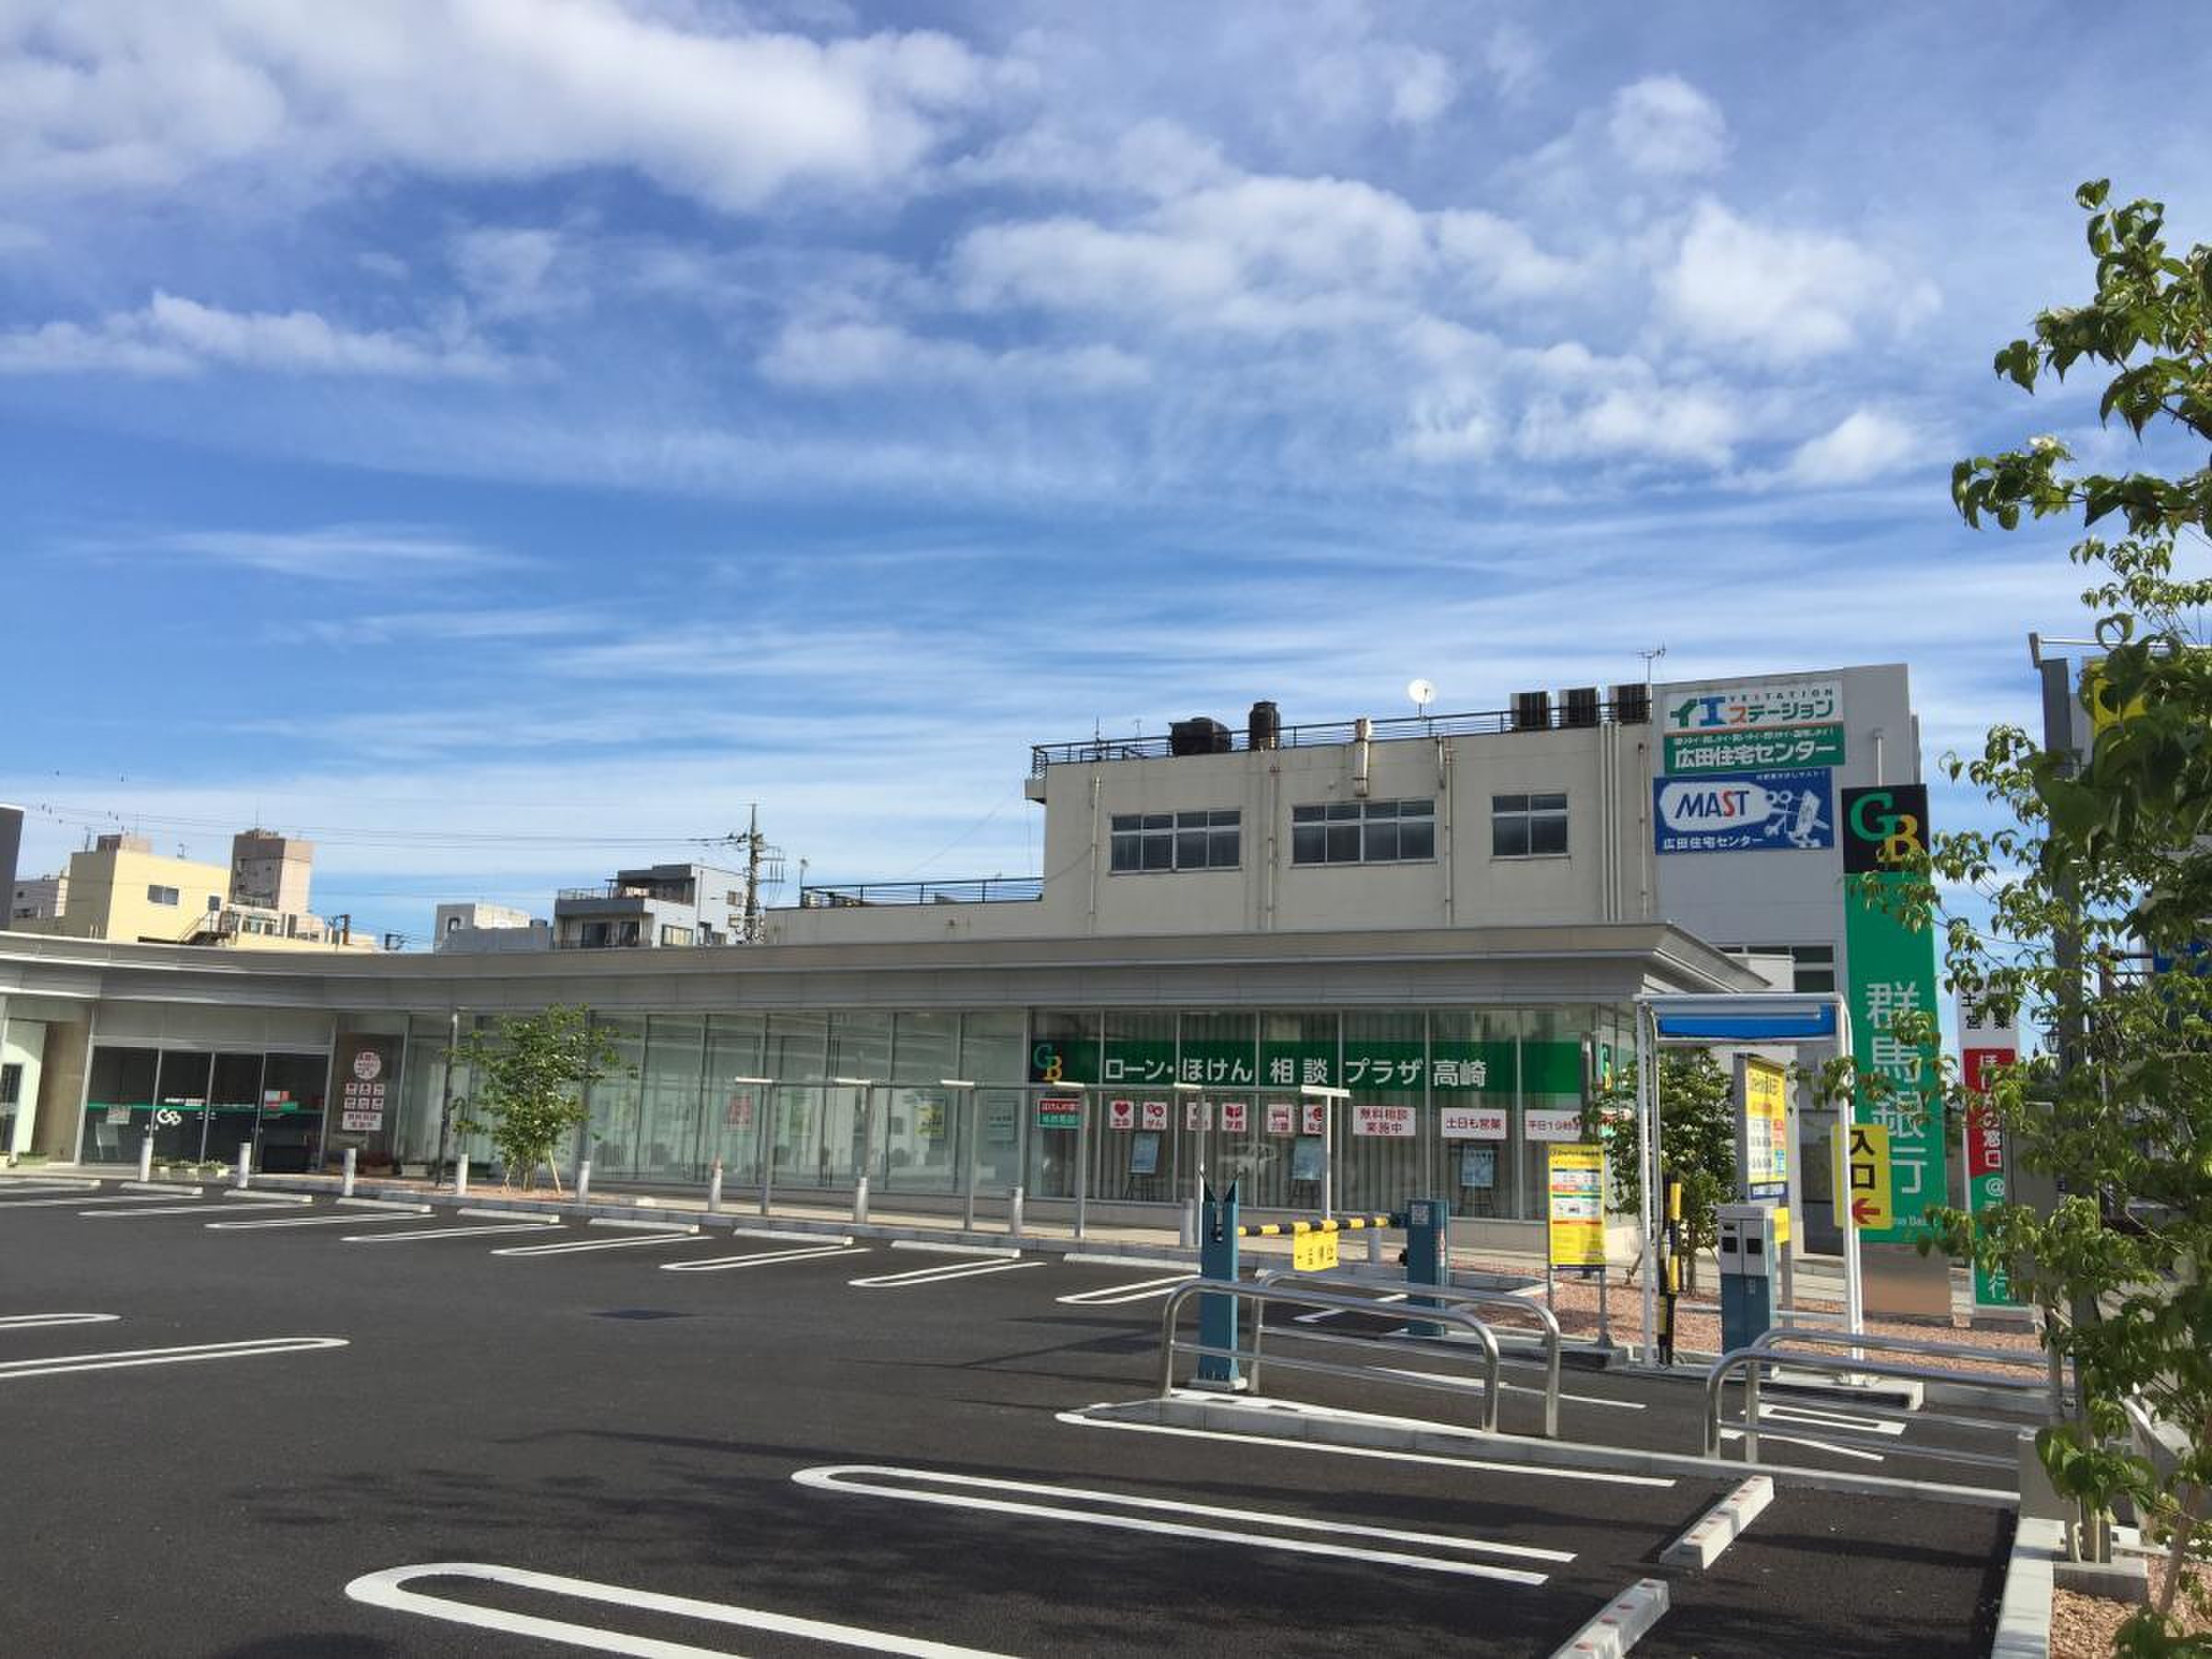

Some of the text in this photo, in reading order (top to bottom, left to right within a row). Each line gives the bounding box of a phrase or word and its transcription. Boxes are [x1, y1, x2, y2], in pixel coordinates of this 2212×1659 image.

[1669, 695, 1834, 727] イエステーション
[1675, 740, 1837, 769] 広田住宅センター
[1675, 790, 1749, 819] MAST
[1663, 835, 1764, 851] 広田住宅センター
[1850, 1130, 1877, 1191] 入口
